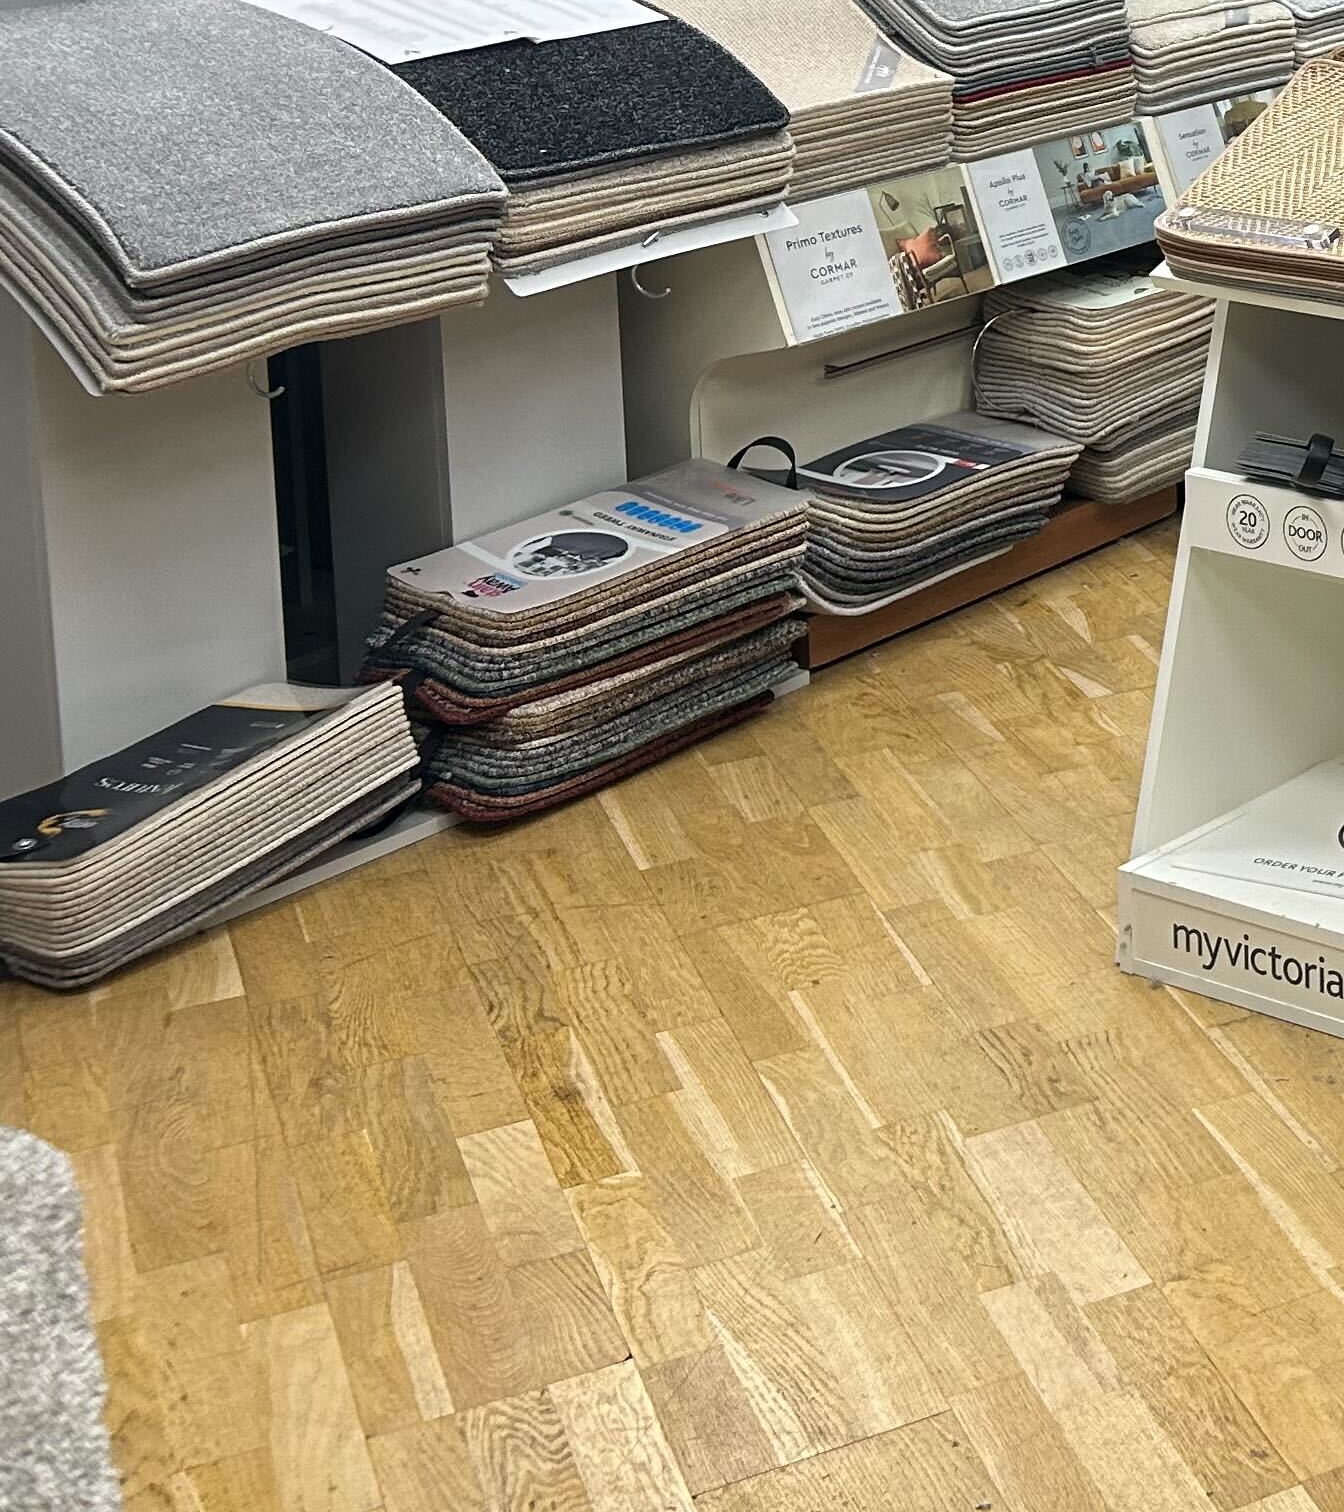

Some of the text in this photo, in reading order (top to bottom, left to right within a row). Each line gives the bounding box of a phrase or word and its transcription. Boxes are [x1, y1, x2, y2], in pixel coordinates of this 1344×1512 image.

[785, 224, 863, 251] Primo Textures
[810, 258, 857, 279] CORMAR
[1239, 511, 1257, 528] 20
[1288, 524, 1323, 543] DOOR
[1298, 544, 1313, 554] OUT
[1253, 857, 1298, 871] ORDER
[1300, 865, 1337, 878] YOUR
